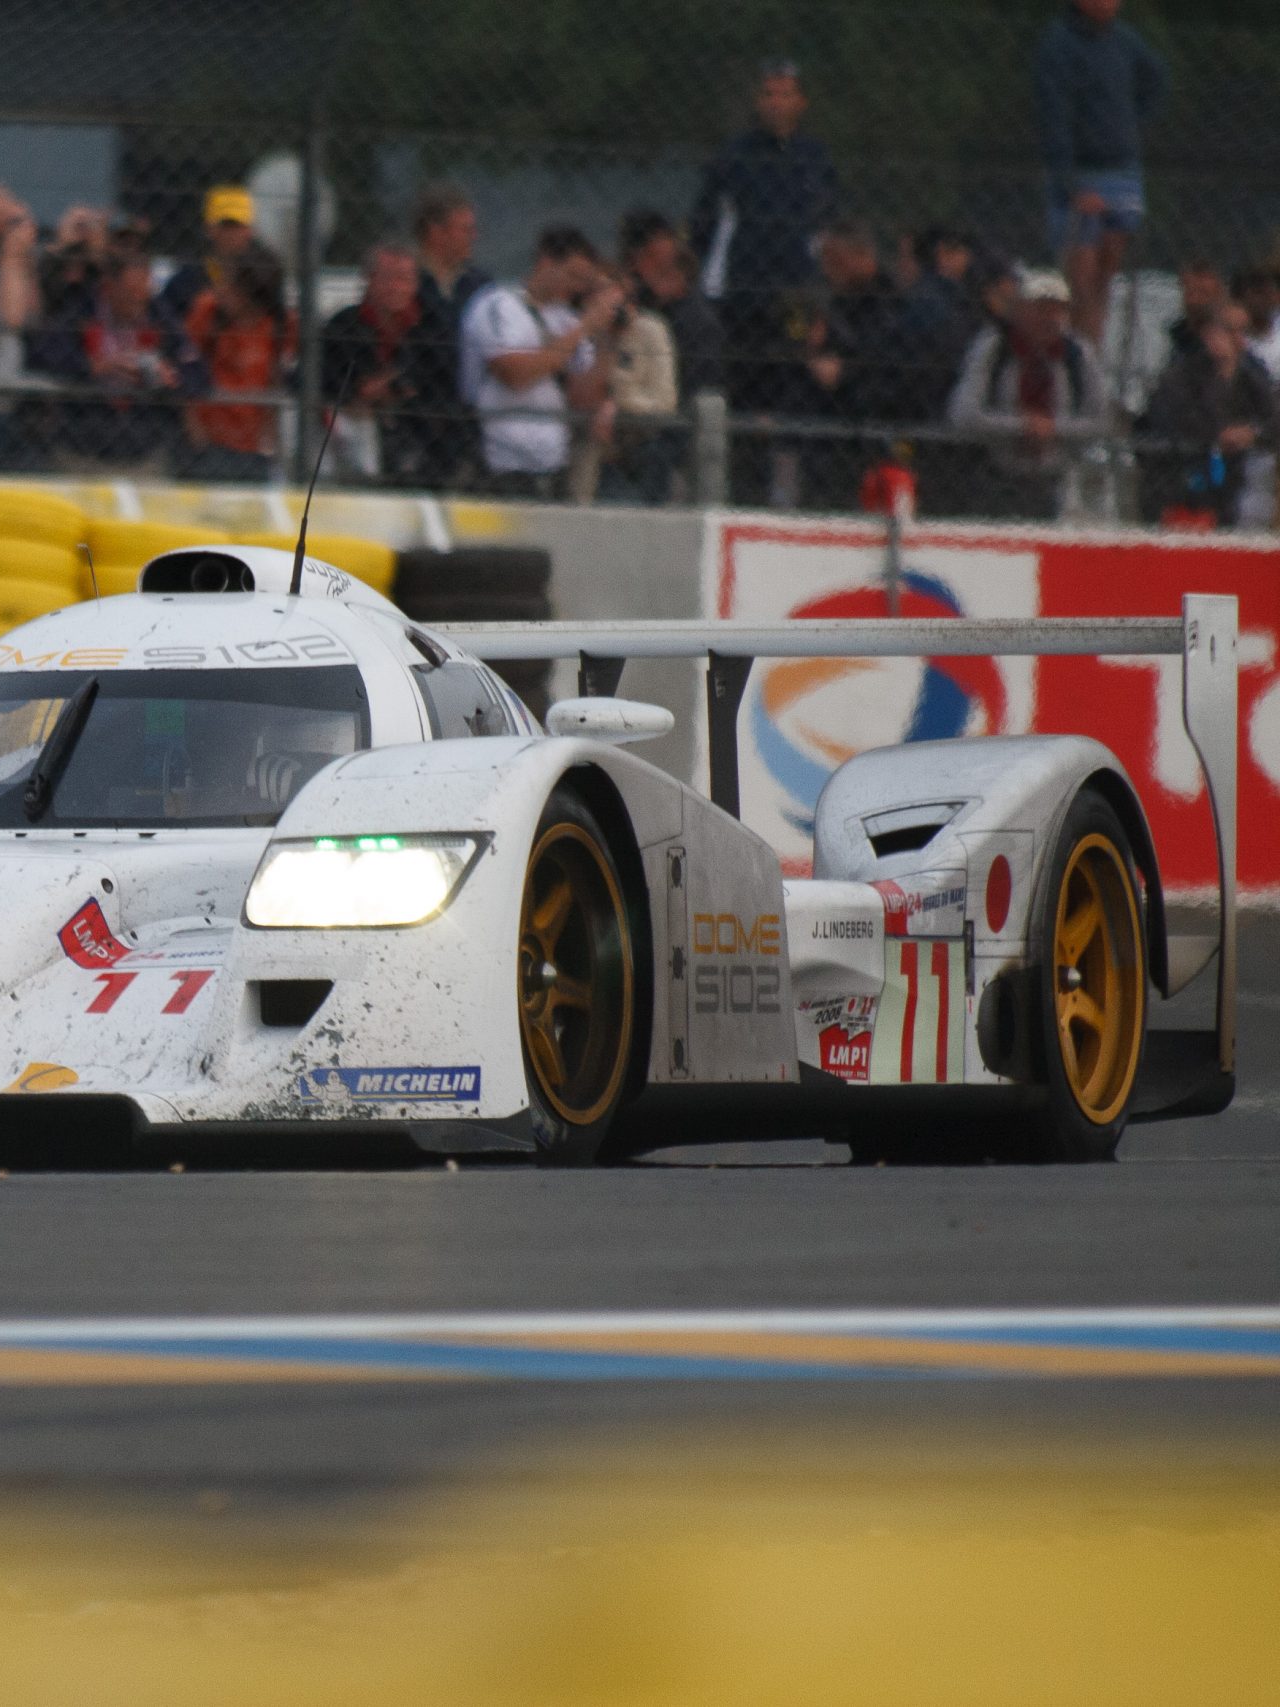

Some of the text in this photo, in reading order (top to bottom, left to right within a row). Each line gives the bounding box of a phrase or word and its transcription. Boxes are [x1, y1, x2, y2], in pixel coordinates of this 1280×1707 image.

[144, 634, 350, 665] S102
[694, 913, 781, 955] DOME
[812, 920, 874, 939] J.LINDEBERG
[84, 969, 217, 1014] 11
[695, 964, 782, 1014] S102
[899, 941, 950, 1083] 11
[828, 1043, 868, 1067] LMP1
[357, 1073, 477, 1092] MICHELIN
